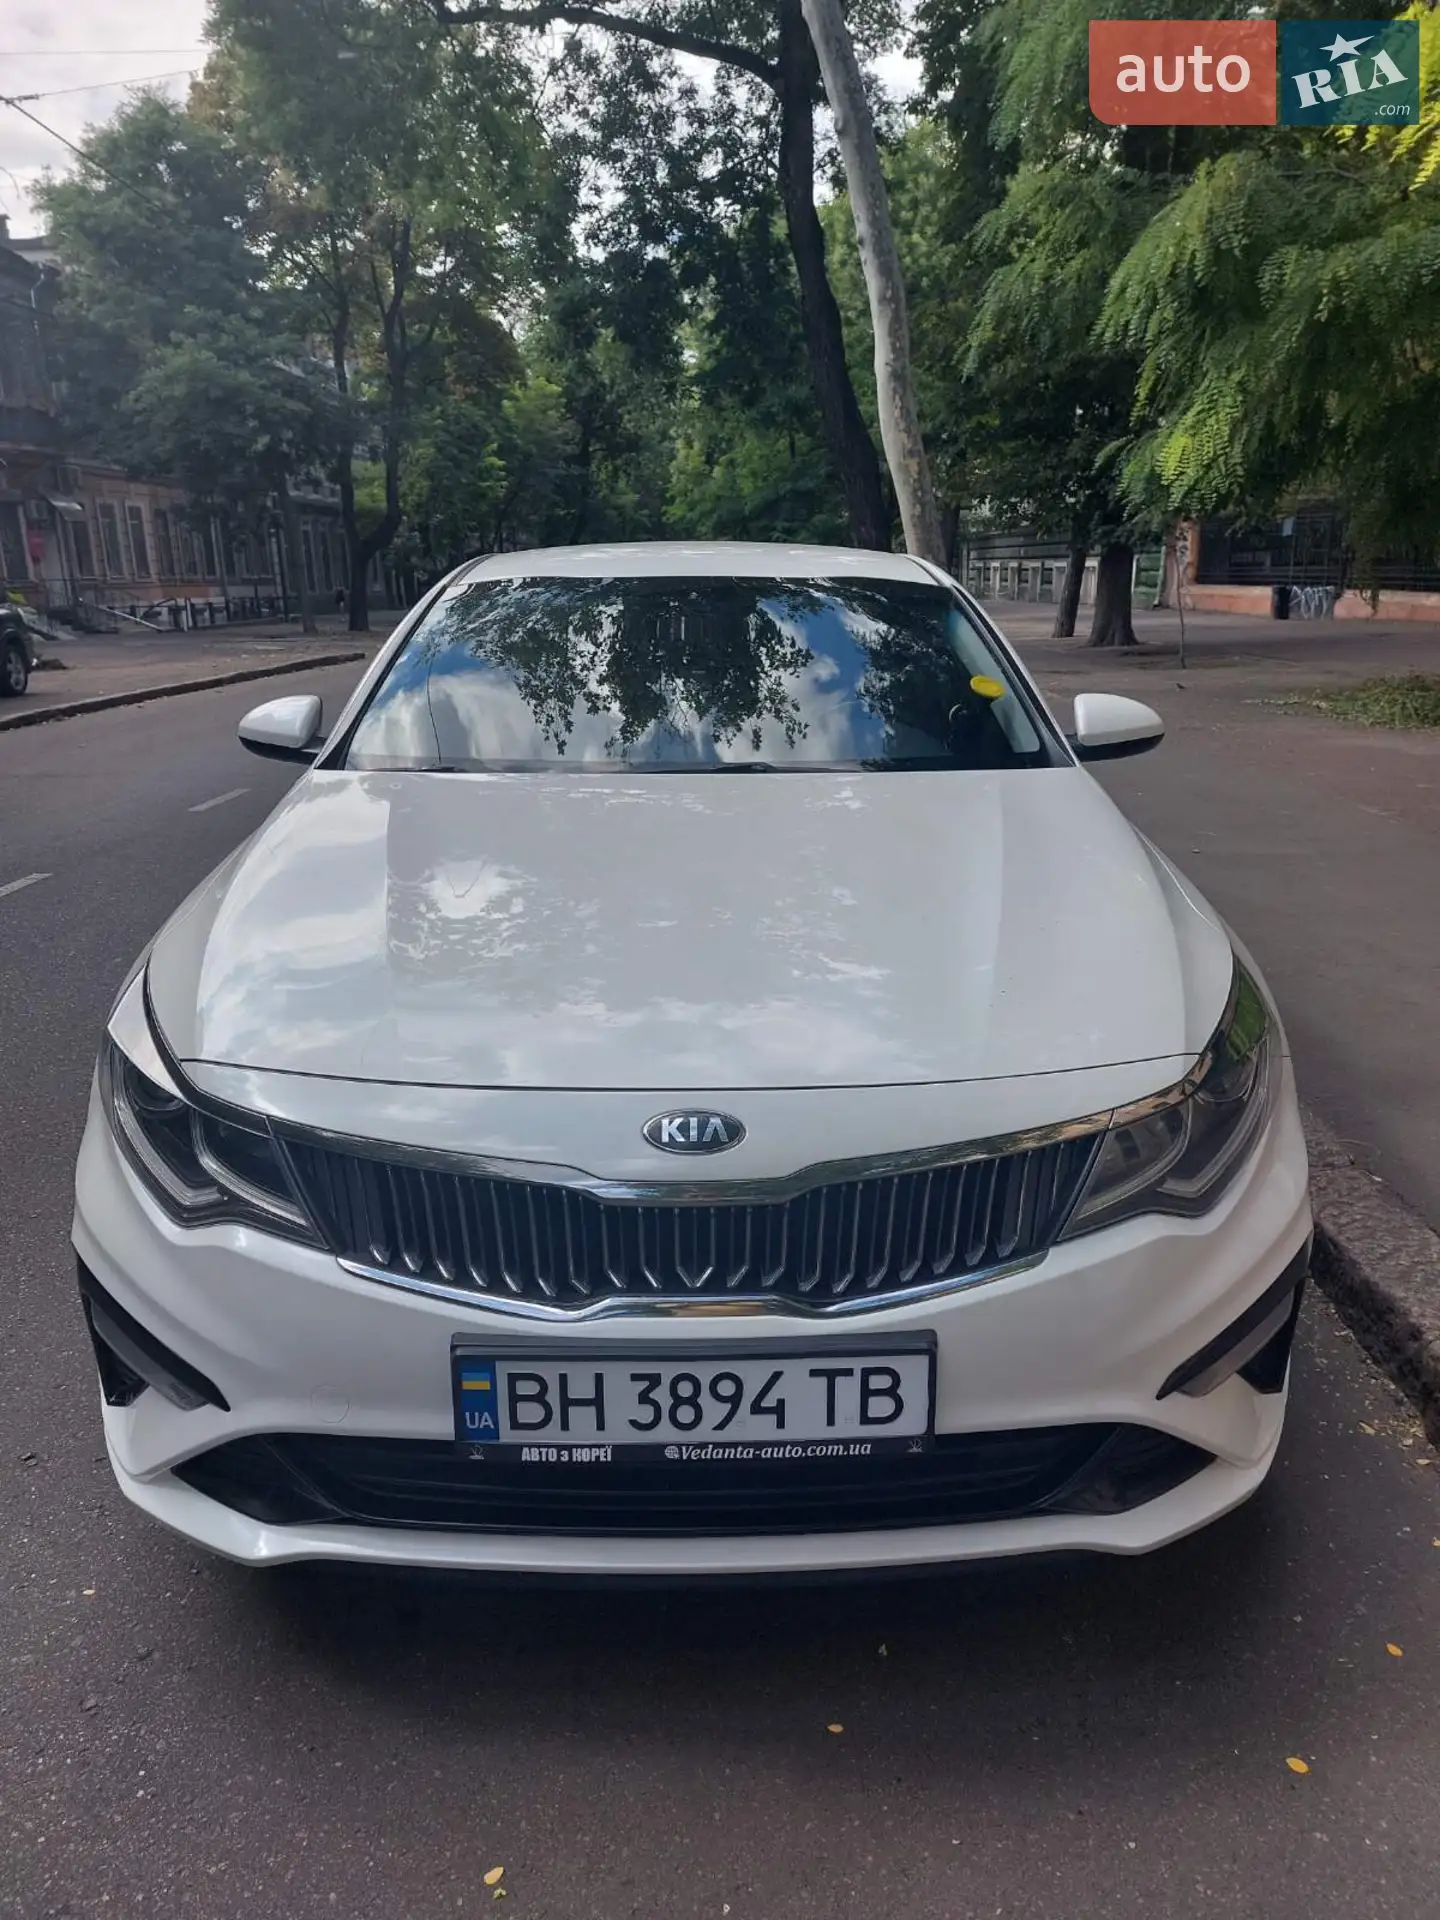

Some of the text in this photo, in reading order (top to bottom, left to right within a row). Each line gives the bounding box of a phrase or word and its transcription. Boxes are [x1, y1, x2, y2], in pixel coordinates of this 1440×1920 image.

[660, 1116, 729, 1143] KIA
[506, 1366, 905, 1433] BH 3894 TB
[464, 1411, 495, 1430] UA
[521, 1446, 558, 1462] АВТО
[572, 1445, 613, 1463] КОРЕЇ
